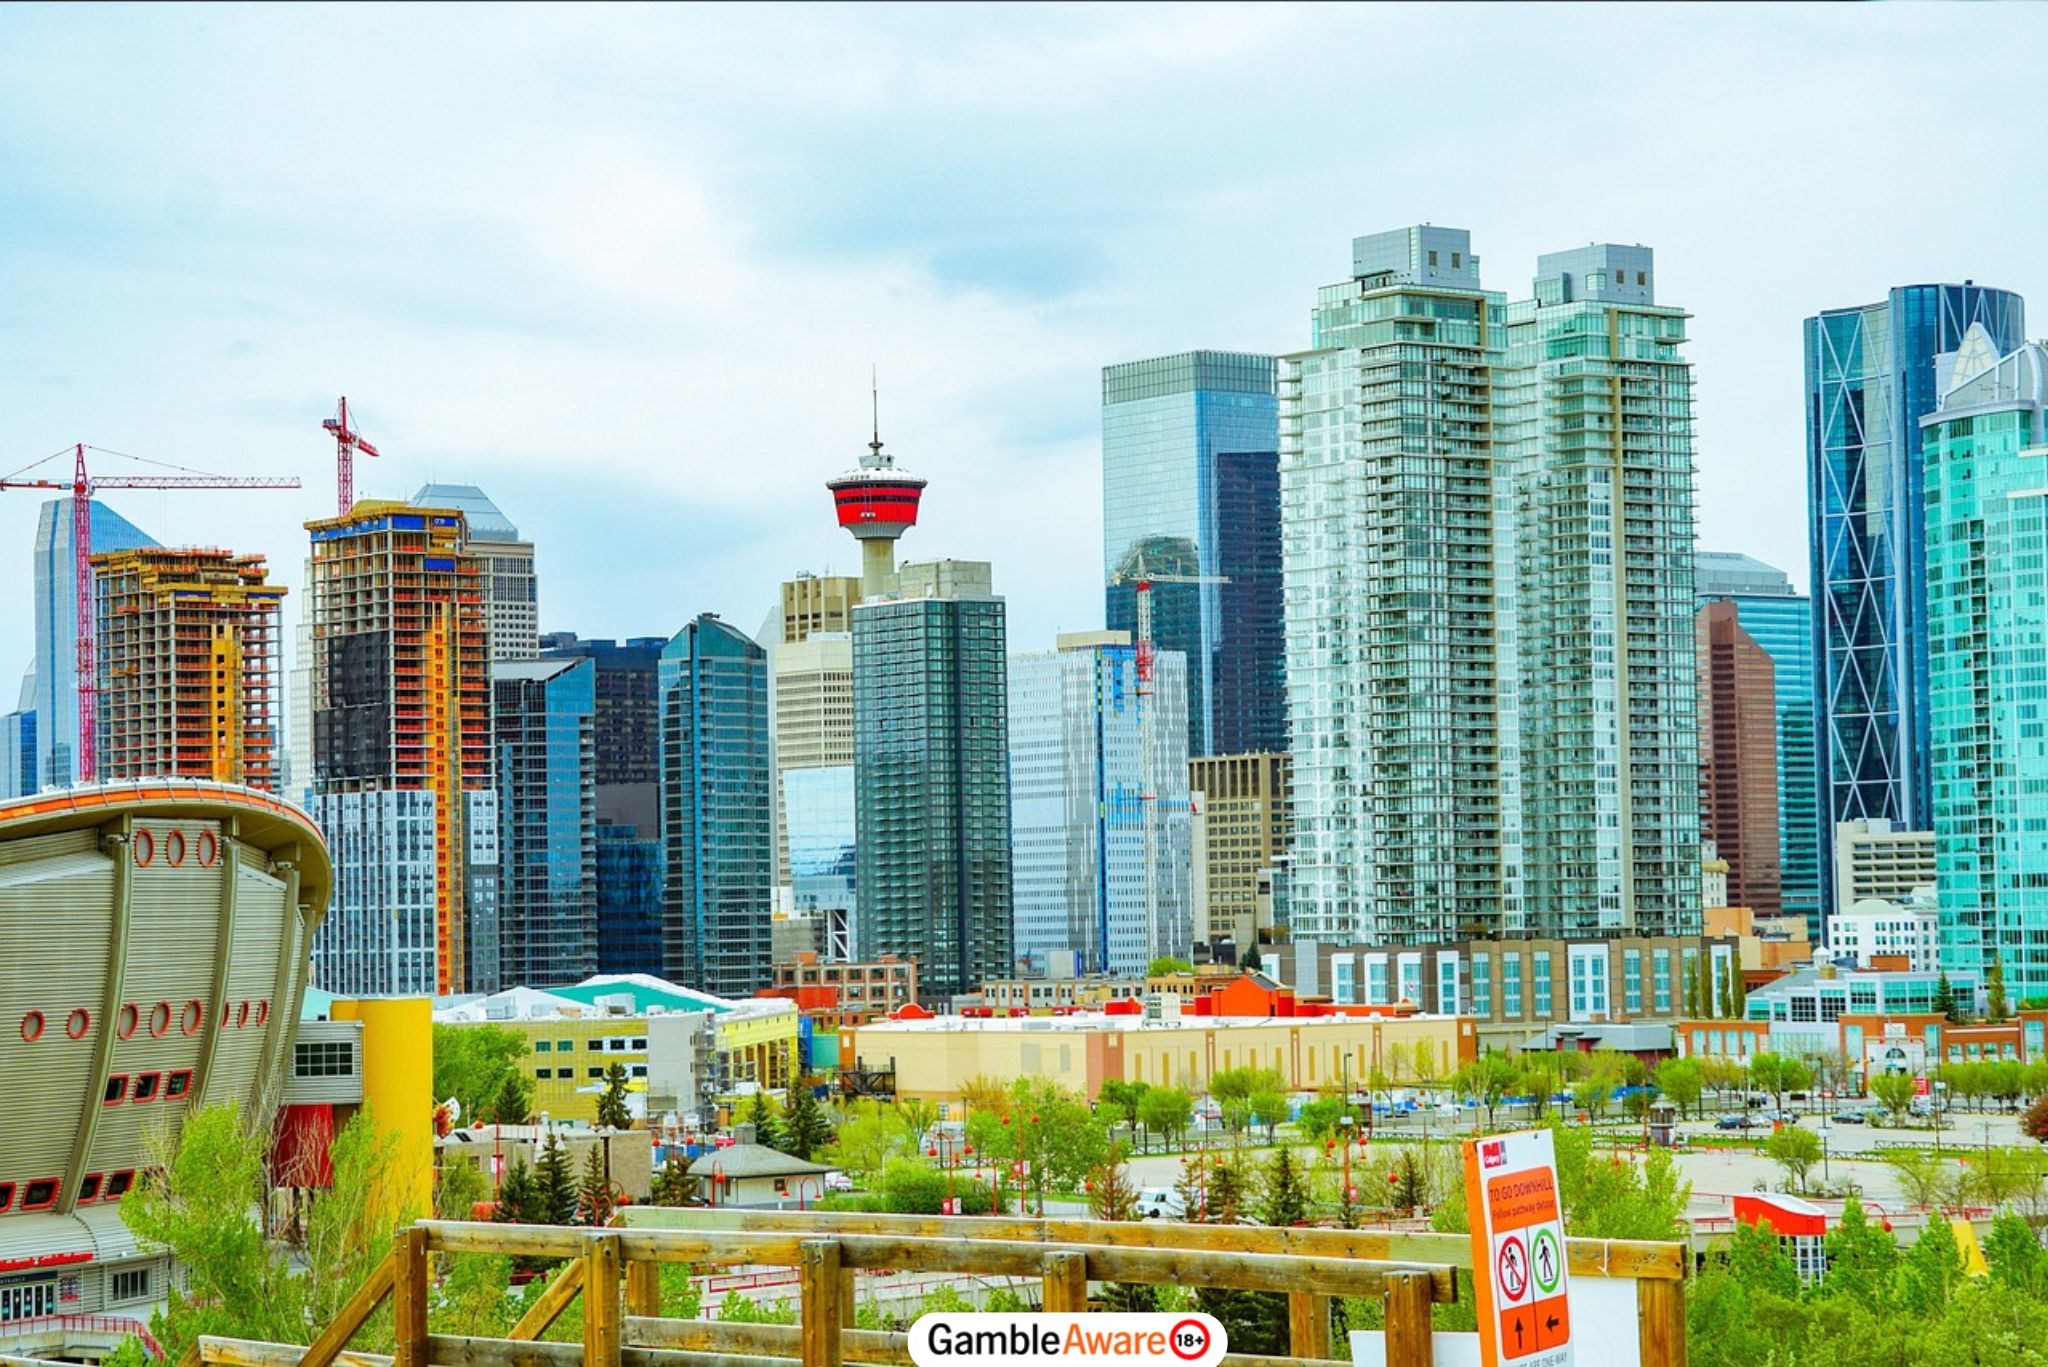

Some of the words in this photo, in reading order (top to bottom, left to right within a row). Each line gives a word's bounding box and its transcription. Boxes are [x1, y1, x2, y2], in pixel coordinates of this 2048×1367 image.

[1490, 1188, 1500, 1201] TO
[1502, 1185, 1513, 1200] GO
[1513, 1177, 1554, 1197] DOWNHILL
